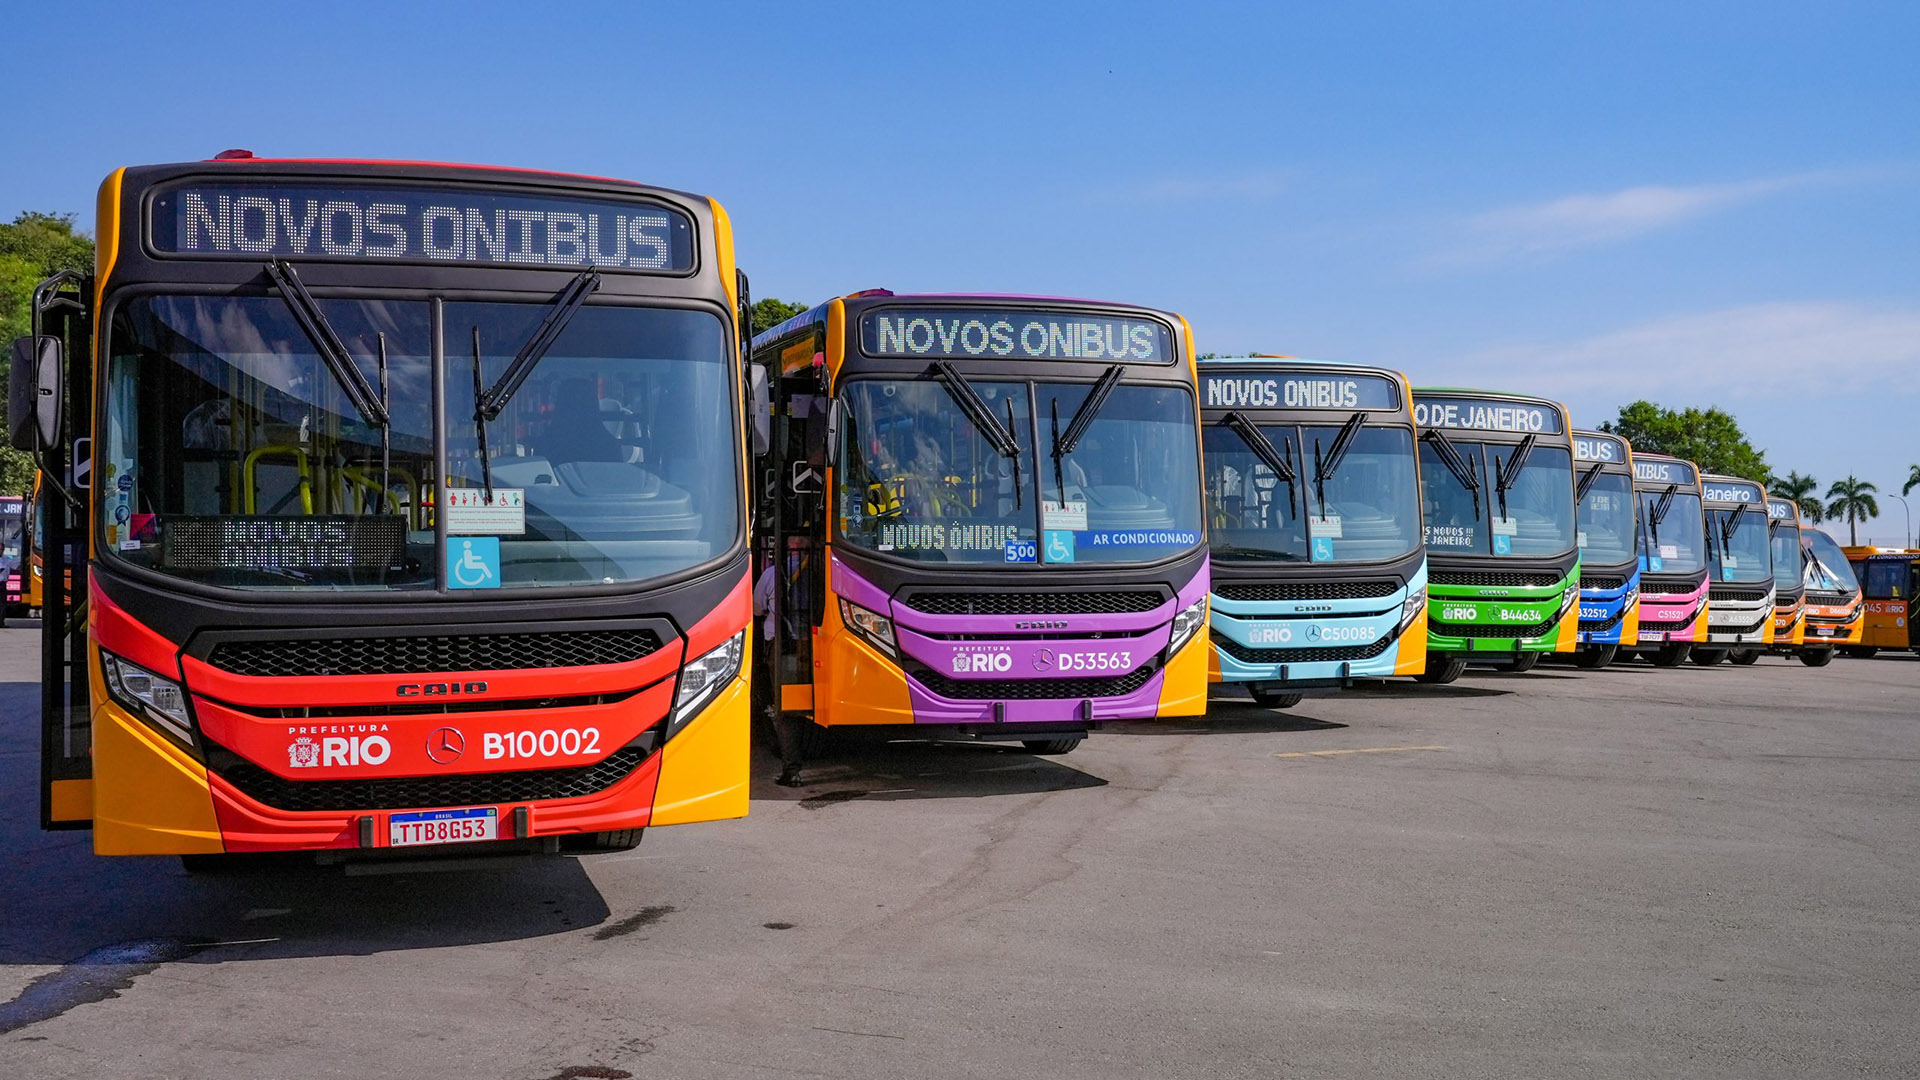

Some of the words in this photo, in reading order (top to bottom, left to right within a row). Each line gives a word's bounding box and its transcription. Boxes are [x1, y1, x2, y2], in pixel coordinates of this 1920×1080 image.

[186, 193, 407, 257] NOVOS
[423, 206, 667, 268] ONIBUS
[879, 318, 1014, 355] NOVOS
[1020, 322, 1153, 358] ONIBUS
[1208, 379, 1278, 406] NOVOS
[1284, 380, 1357, 407] ONIBUS
[1431, 404, 1458, 427] DE
[1460, 406, 1543, 431] JANEIRO
[1702, 485, 1750, 501] Janeiro
[224, 521, 346, 542] NOVOS
[883, 524, 945, 550] NOVOS
[1093, 534, 1109, 545] AR
[1112, 532, 1195, 544] CONDICIONADO
[1433, 527, 1464, 536] NOVOS
[1007, 545, 1035, 561] 5,00
[1454, 608, 1477, 620] RIO
[1501, 609, 1541, 621] B44634
[1263, 628, 1292, 642] RIO
[1321, 627, 1375, 640] C50085
[972, 653, 1012, 672] RIO
[1058, 652, 1131, 670] D53563
[396, 681, 487, 696] CAIO
[288, 724, 389, 734] PREFEITURA
[322, 735, 391, 766] RIO
[483, 727, 600, 759] B10002
[400, 819, 485, 842] TTB8G53
